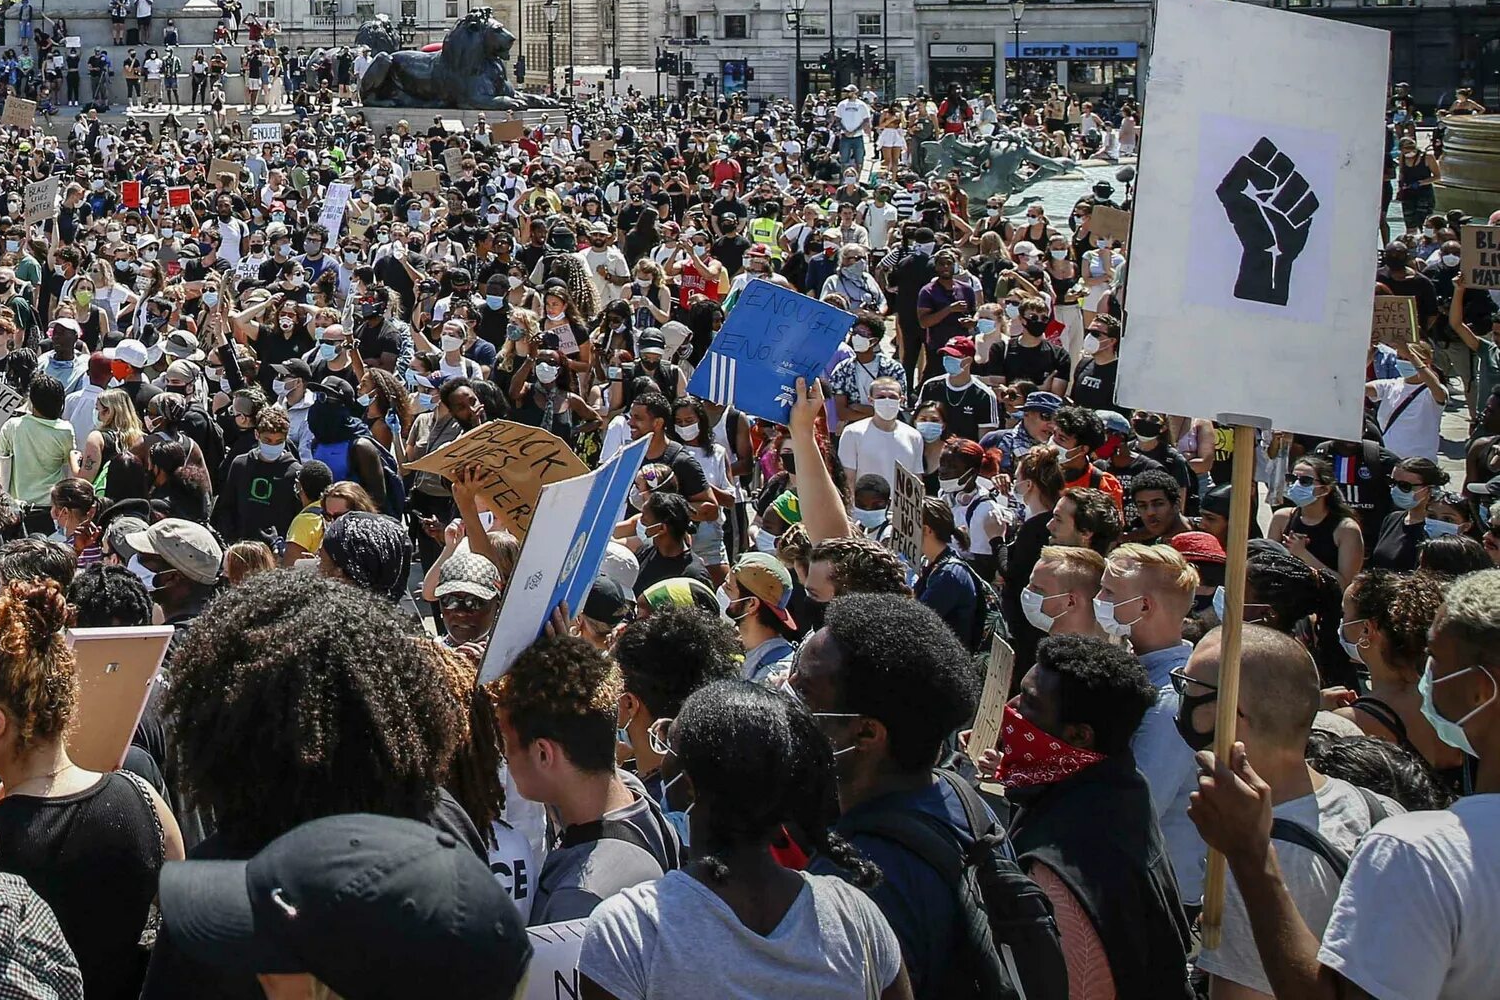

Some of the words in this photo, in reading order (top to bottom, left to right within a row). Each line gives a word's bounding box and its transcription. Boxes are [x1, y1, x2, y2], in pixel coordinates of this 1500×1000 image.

[1023, 44, 1070, 56] CAFFÈ
[1076, 47, 1118, 56] NERO
[252, 127, 280, 140] ENOUGH
[29, 185, 49, 197] BLACK
[29, 202, 50, 216] MATTER
[1476, 231, 1500, 249] BL
[746, 286, 838, 334] ENOUGH
[1374, 302, 1405, 313] LACK
[1376, 315, 1406, 324] IVES
[765, 318, 790, 343] IS
[1372, 327, 1413, 339] ATTER
[443, 442, 519, 470] LIVES
[470, 422, 569, 479] BLACK
[896, 468, 914, 498] NO
[901, 513, 914, 538] NO
[891, 527, 918, 565] PEACE
